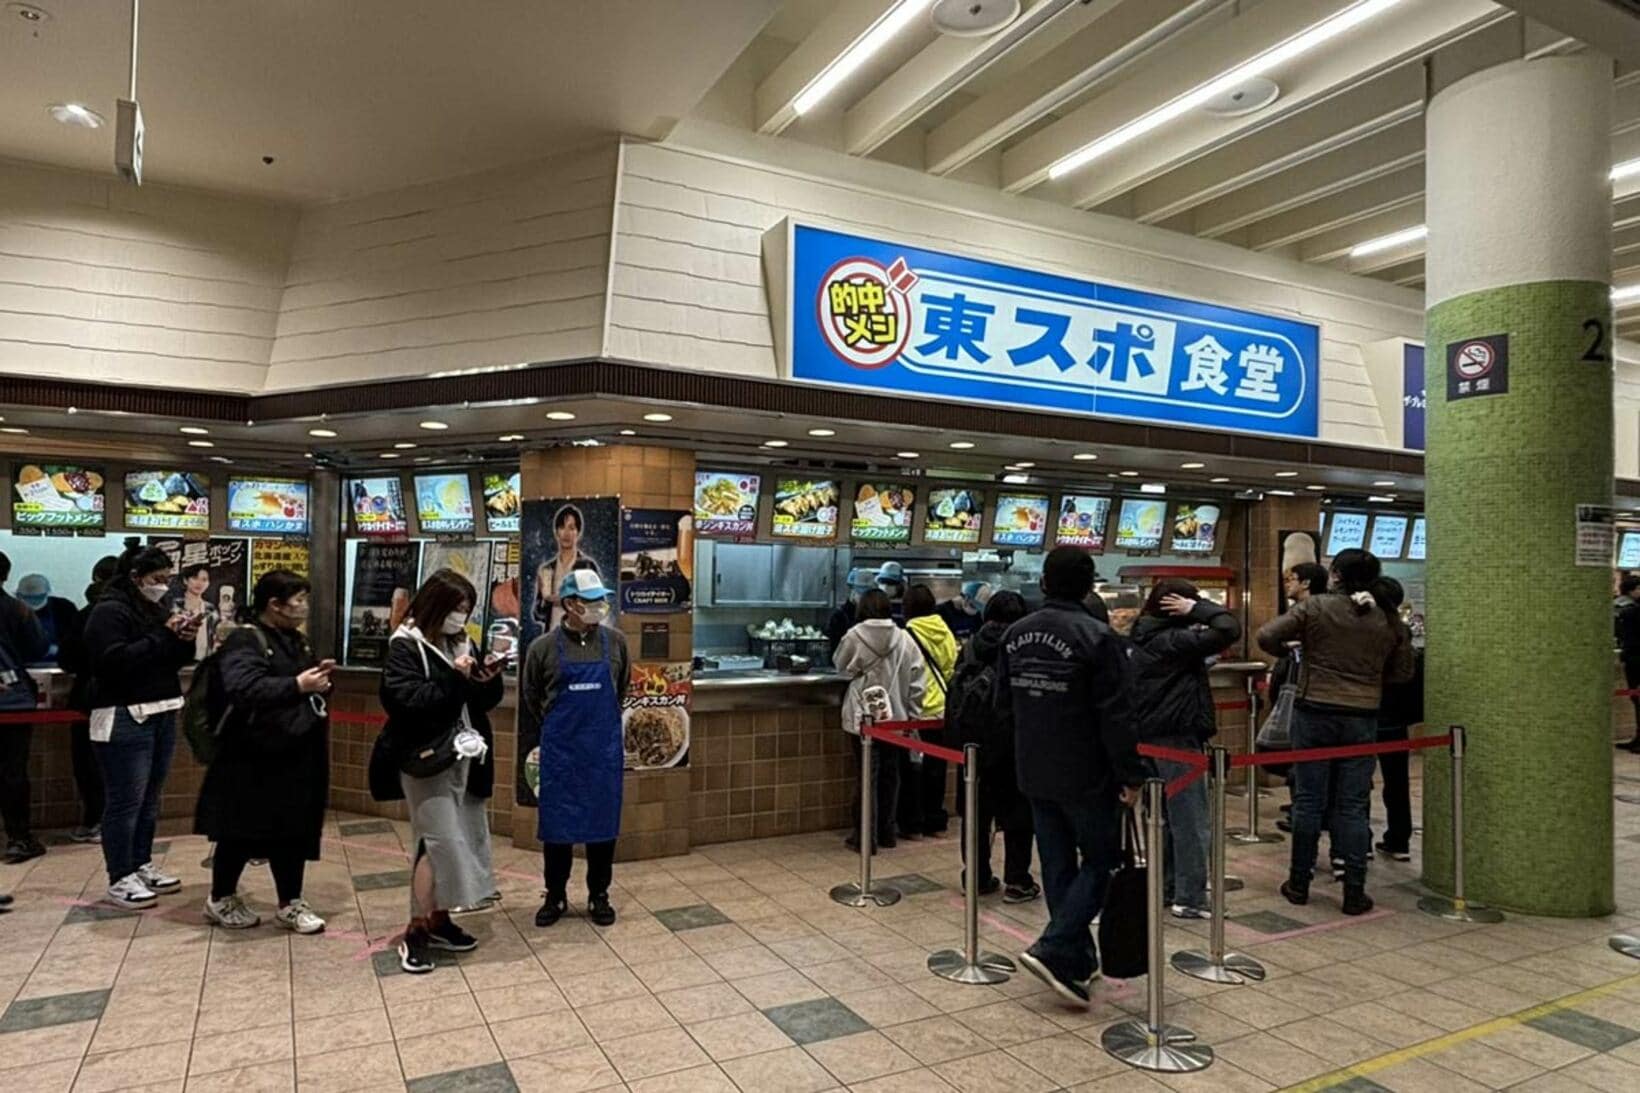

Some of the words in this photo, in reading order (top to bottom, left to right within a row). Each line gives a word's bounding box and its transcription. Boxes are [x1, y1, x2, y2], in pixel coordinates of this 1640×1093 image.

[829, 280, 886, 316] 的中
[844, 312, 897, 346] メシ
[1581, 318, 1606, 362] 2
[1458, 378, 1491, 394] 禁煙
